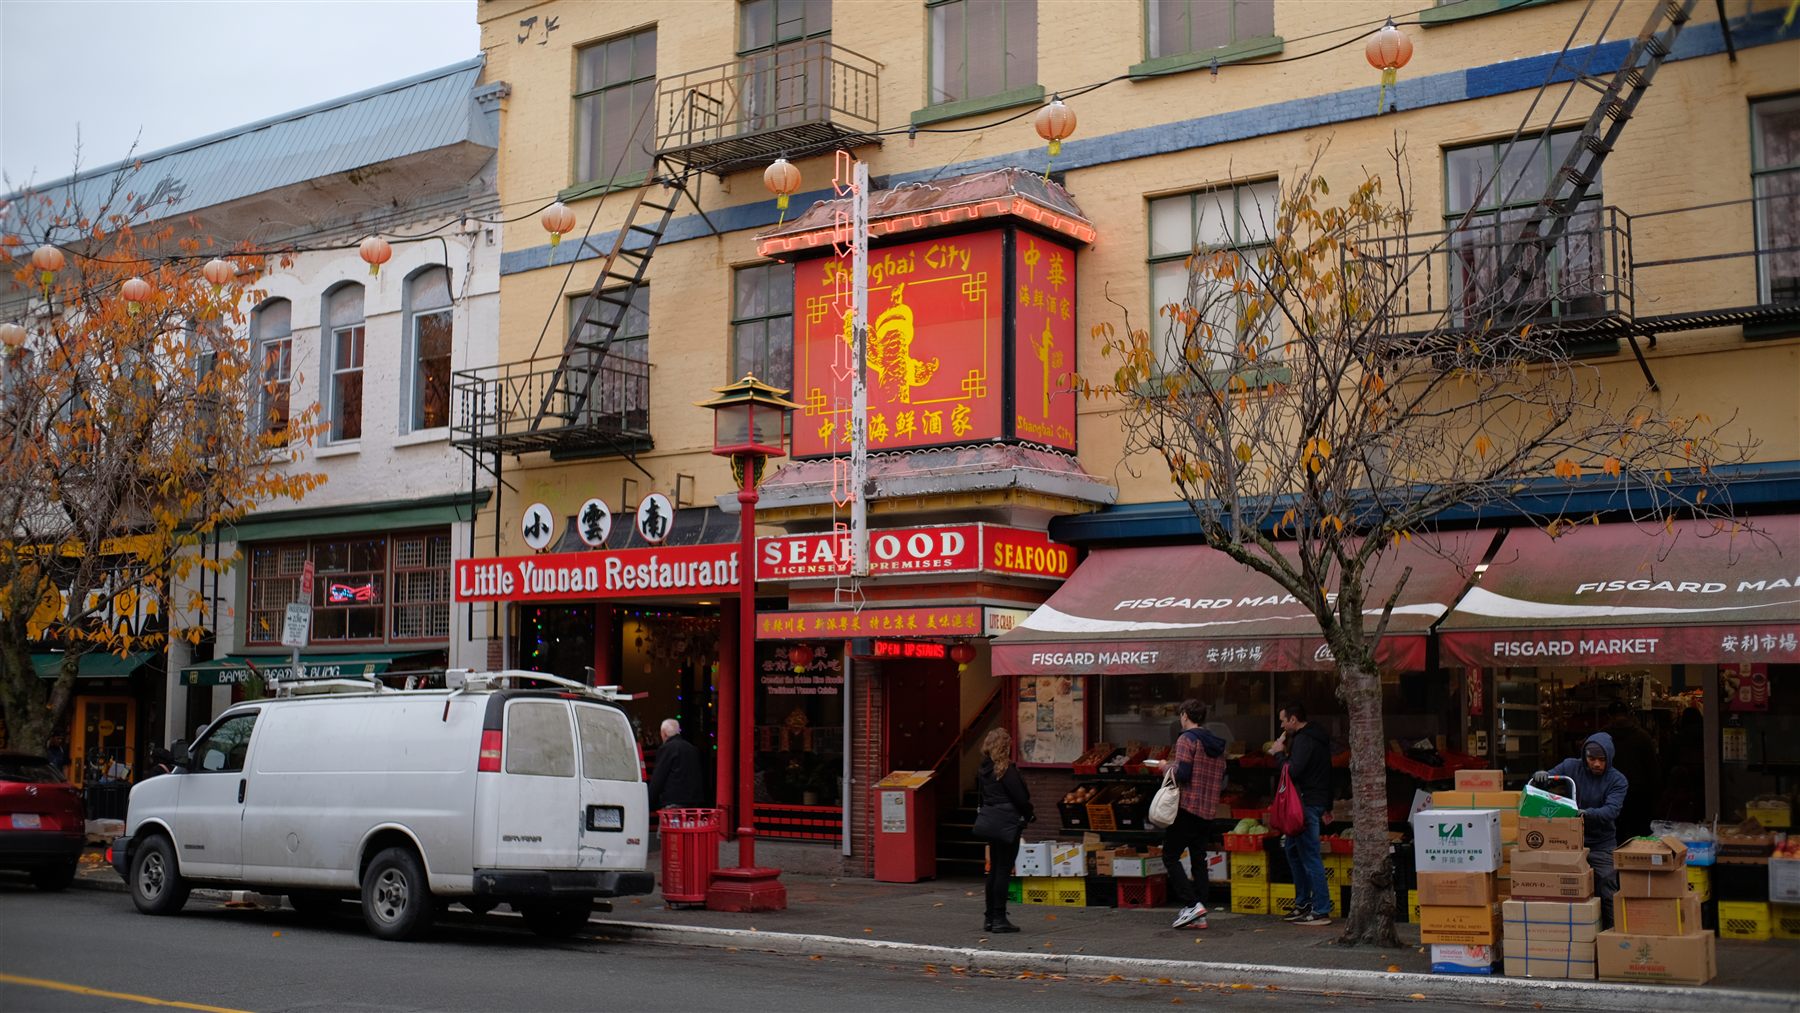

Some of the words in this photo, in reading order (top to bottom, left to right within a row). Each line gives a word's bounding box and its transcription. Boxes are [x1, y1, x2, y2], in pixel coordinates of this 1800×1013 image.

[924, 244, 971, 272] City
[1020, 285, 1070, 320] 海鮮酒家
[1017, 415, 1053, 437] Shanghai
[1056, 425, 1073, 445] City
[870, 558, 953, 570] PREMISES
[994, 542, 1068, 574] SEAFOOD
[459, 563, 515, 597] Little
[518, 560, 598, 593] Yunnan
[604, 552, 740, 590] Restaurant
[1575, 579, 1727, 595] FISGARD
[1113, 596, 1234, 611] FISGARD
[877, 641, 900, 656] OPEN
[1493, 640, 1574, 657] FISGARD
[1579, 638, 1659, 655] MARKET
[1720, 633, 1799, 653] 安利市場
[1031, 652, 1095, 665] FISGARD
[1098, 651, 1159, 665] MARKET
[1205, 646, 1263, 663] 安利市場
